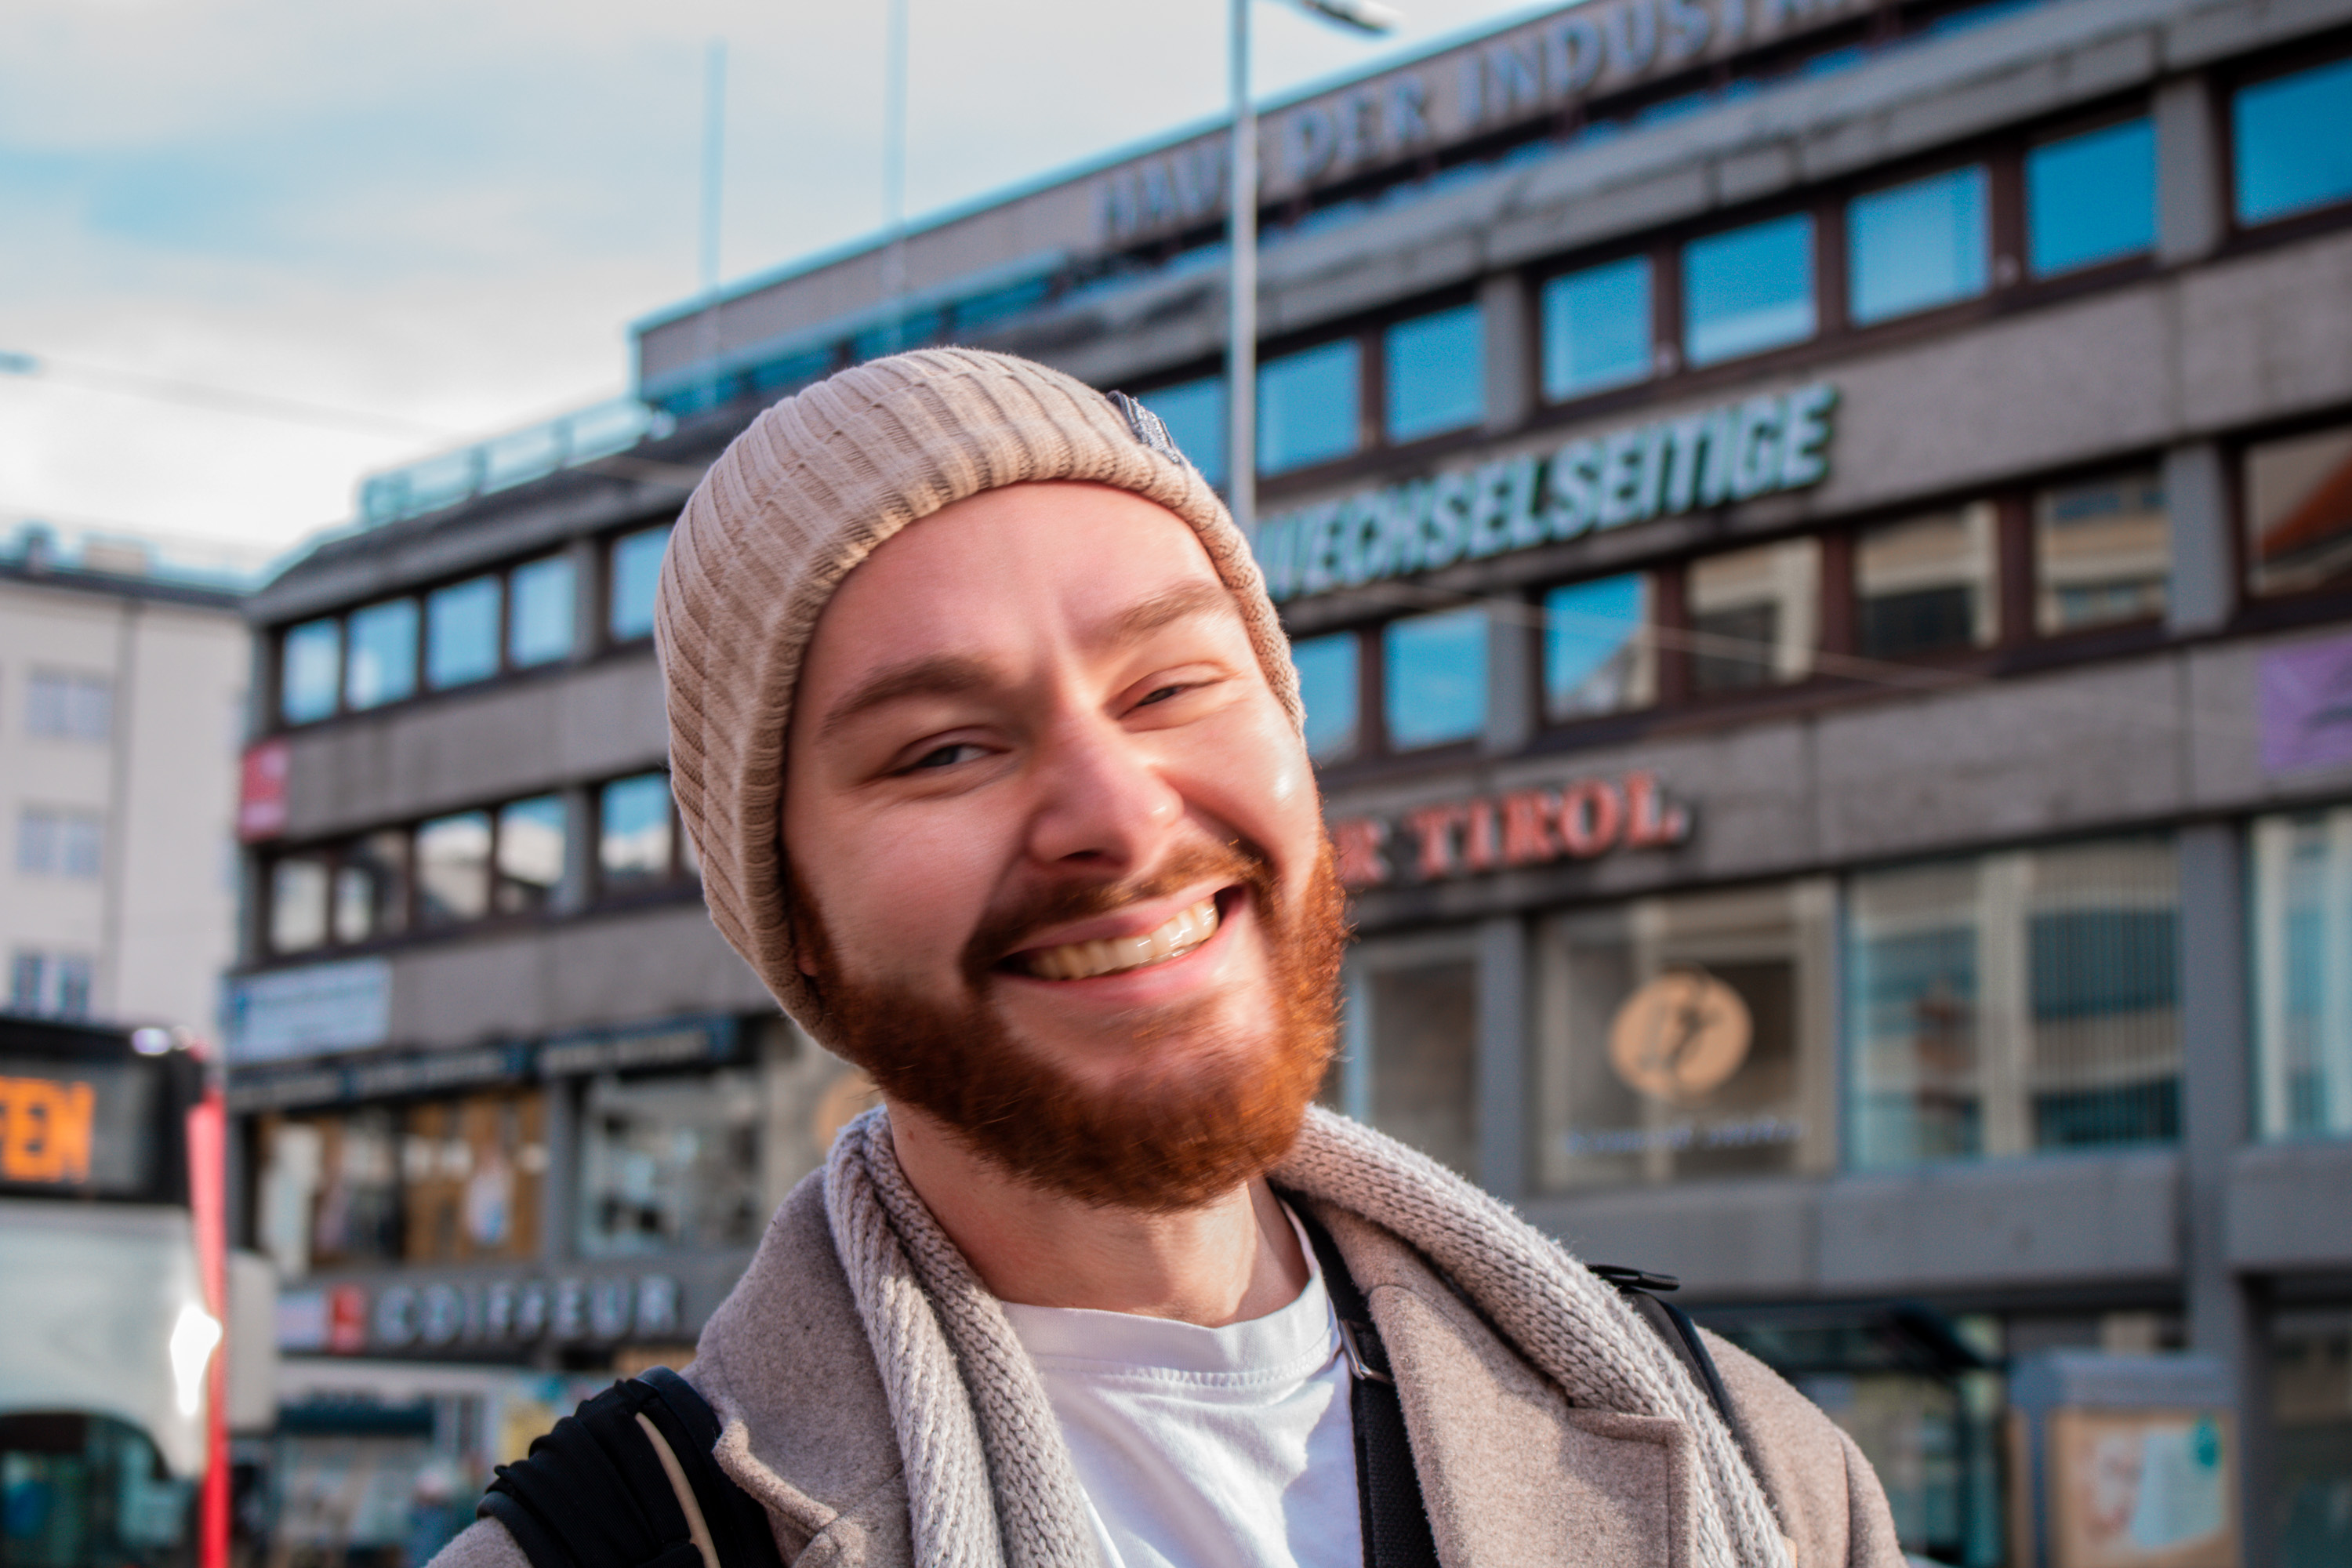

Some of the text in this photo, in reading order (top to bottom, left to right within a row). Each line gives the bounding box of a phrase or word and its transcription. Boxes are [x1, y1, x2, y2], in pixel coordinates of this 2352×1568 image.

[1090, 135, 1261, 245] HAU
[1283, 75, 1430, 187] DER
[376, 1275, 681, 1347] COIFFEUR
